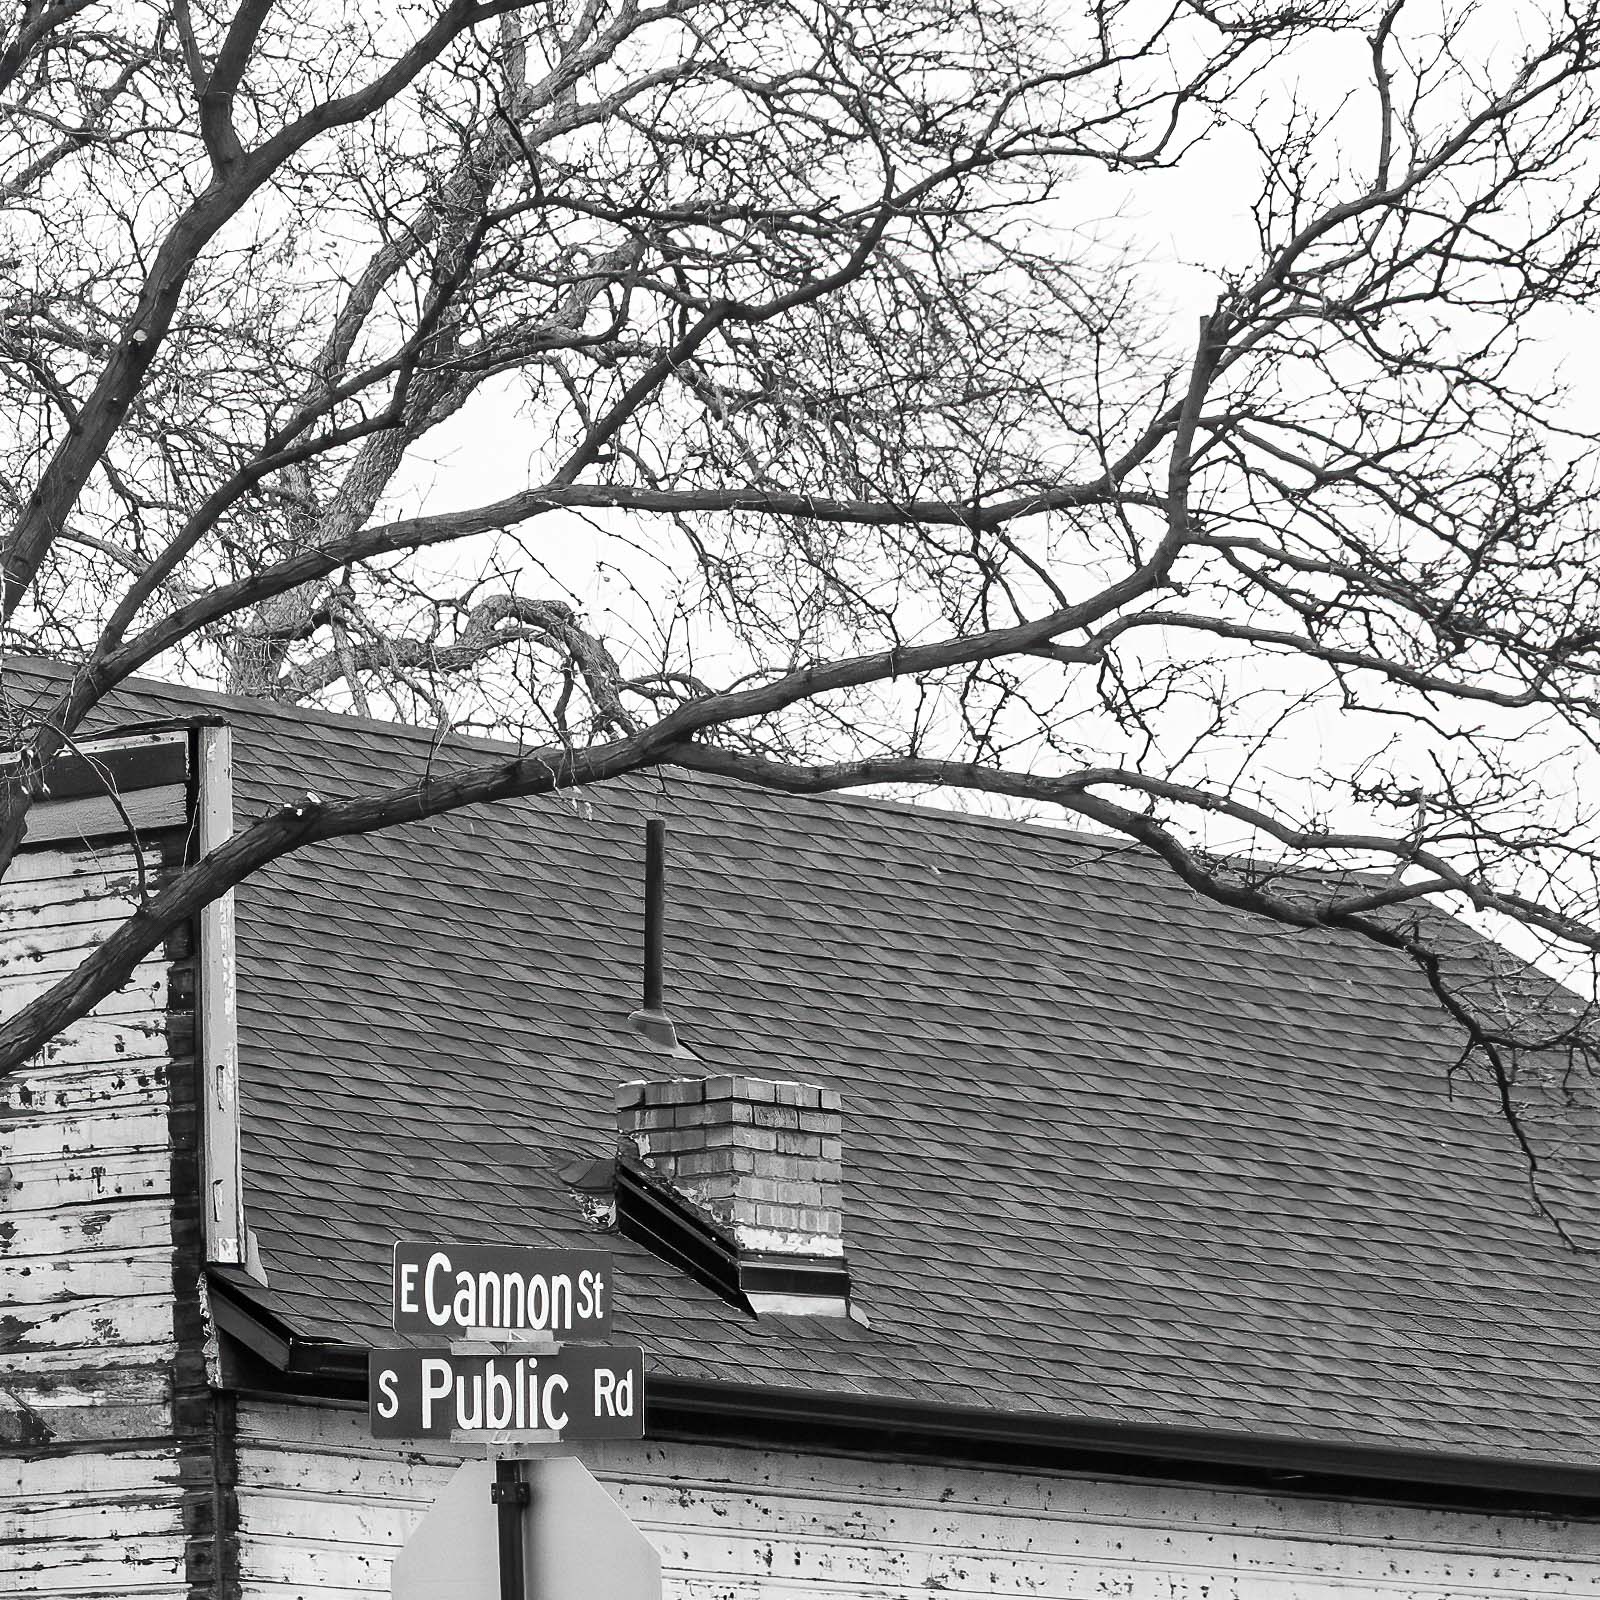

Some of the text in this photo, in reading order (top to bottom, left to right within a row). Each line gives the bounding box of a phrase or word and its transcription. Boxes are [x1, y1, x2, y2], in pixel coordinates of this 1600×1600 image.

[400, 1252, 604, 1330] E Cannon St
[377, 1358, 633, 1430] S Public Rd
